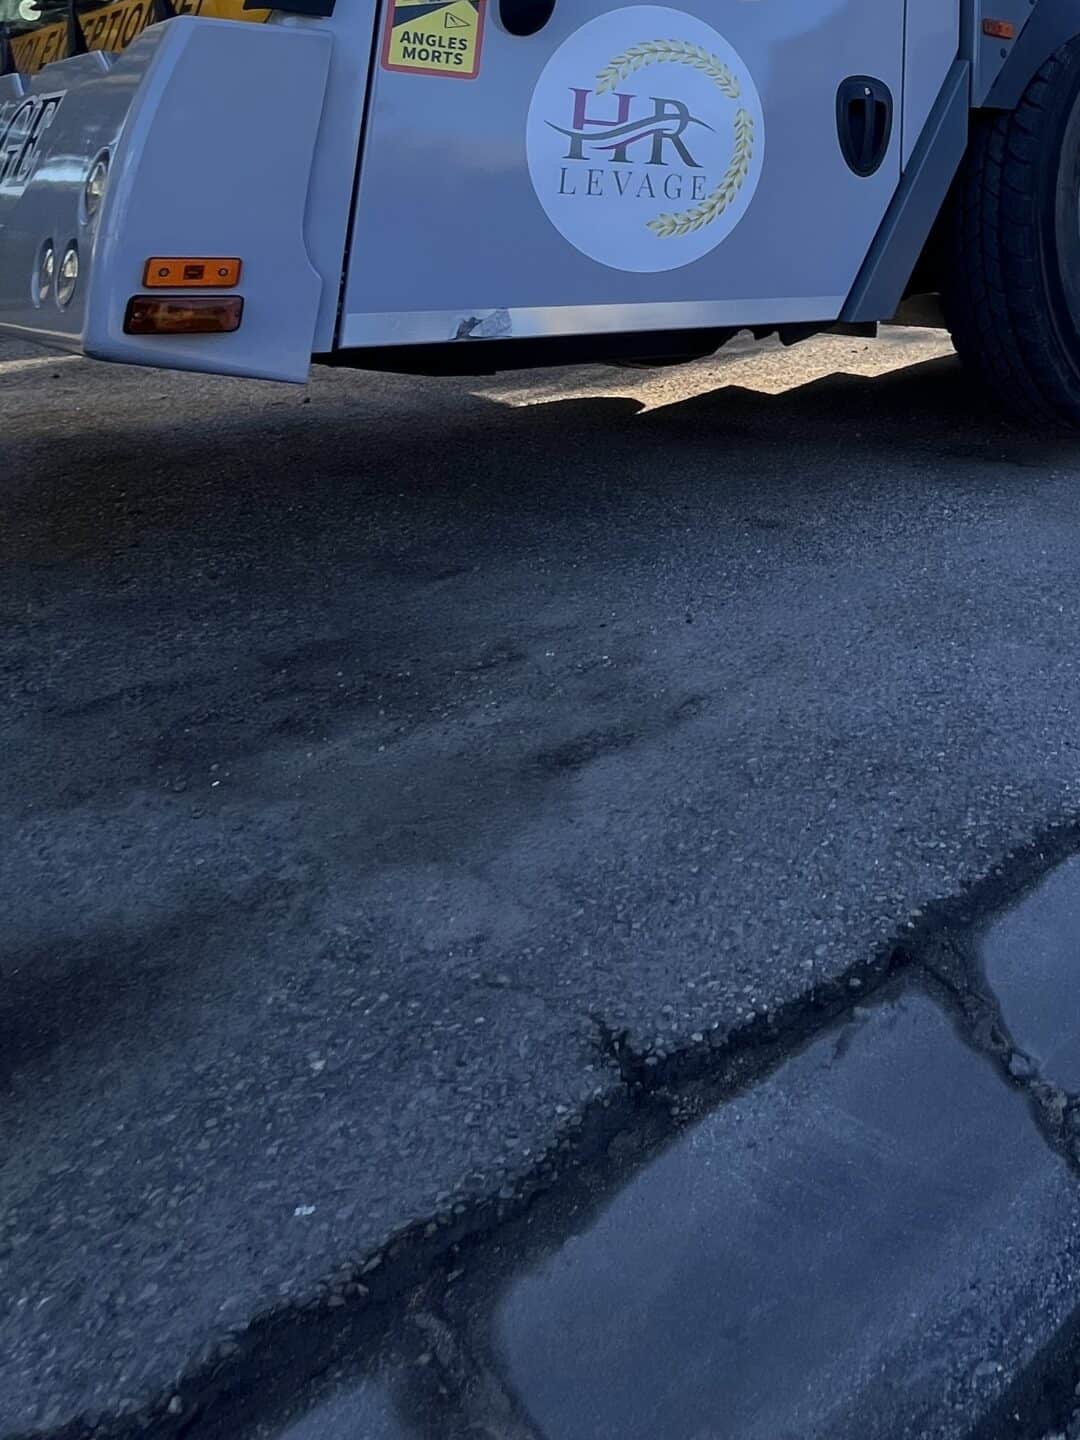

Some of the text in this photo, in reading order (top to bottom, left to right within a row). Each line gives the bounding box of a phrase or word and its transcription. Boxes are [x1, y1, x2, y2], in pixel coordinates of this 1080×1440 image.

[400, 30, 468, 51] ANGLES
[402, 46, 463, 66] MORTS
[560, 87, 705, 168] HR
[557, 167, 707, 201] LEVAGE
